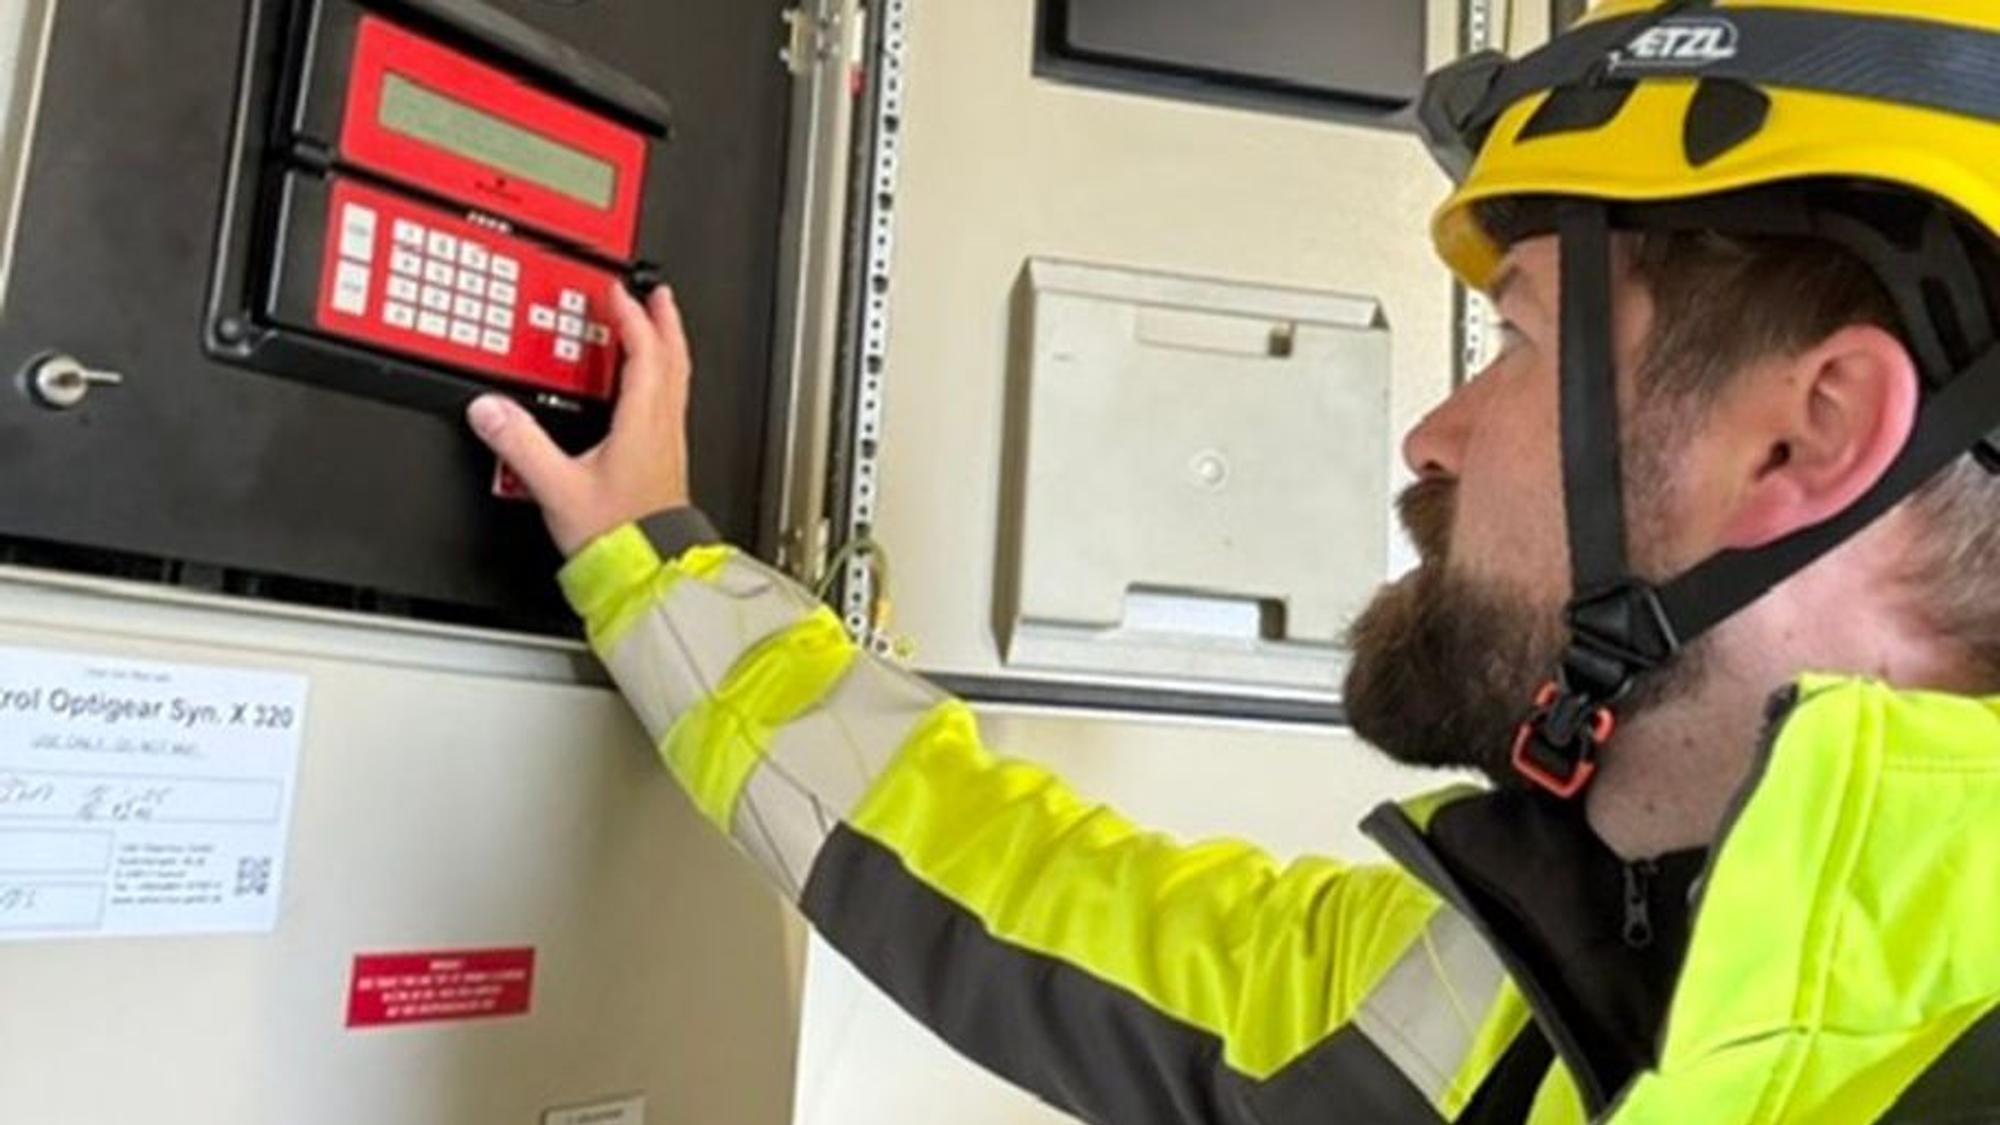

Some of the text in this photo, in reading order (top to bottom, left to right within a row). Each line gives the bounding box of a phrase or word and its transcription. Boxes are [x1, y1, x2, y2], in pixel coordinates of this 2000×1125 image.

[0, 687, 41, 710] rol
[49, 687, 164, 724] Optigear
[228, 702, 247, 725] X
[254, 703, 294, 729] 320
